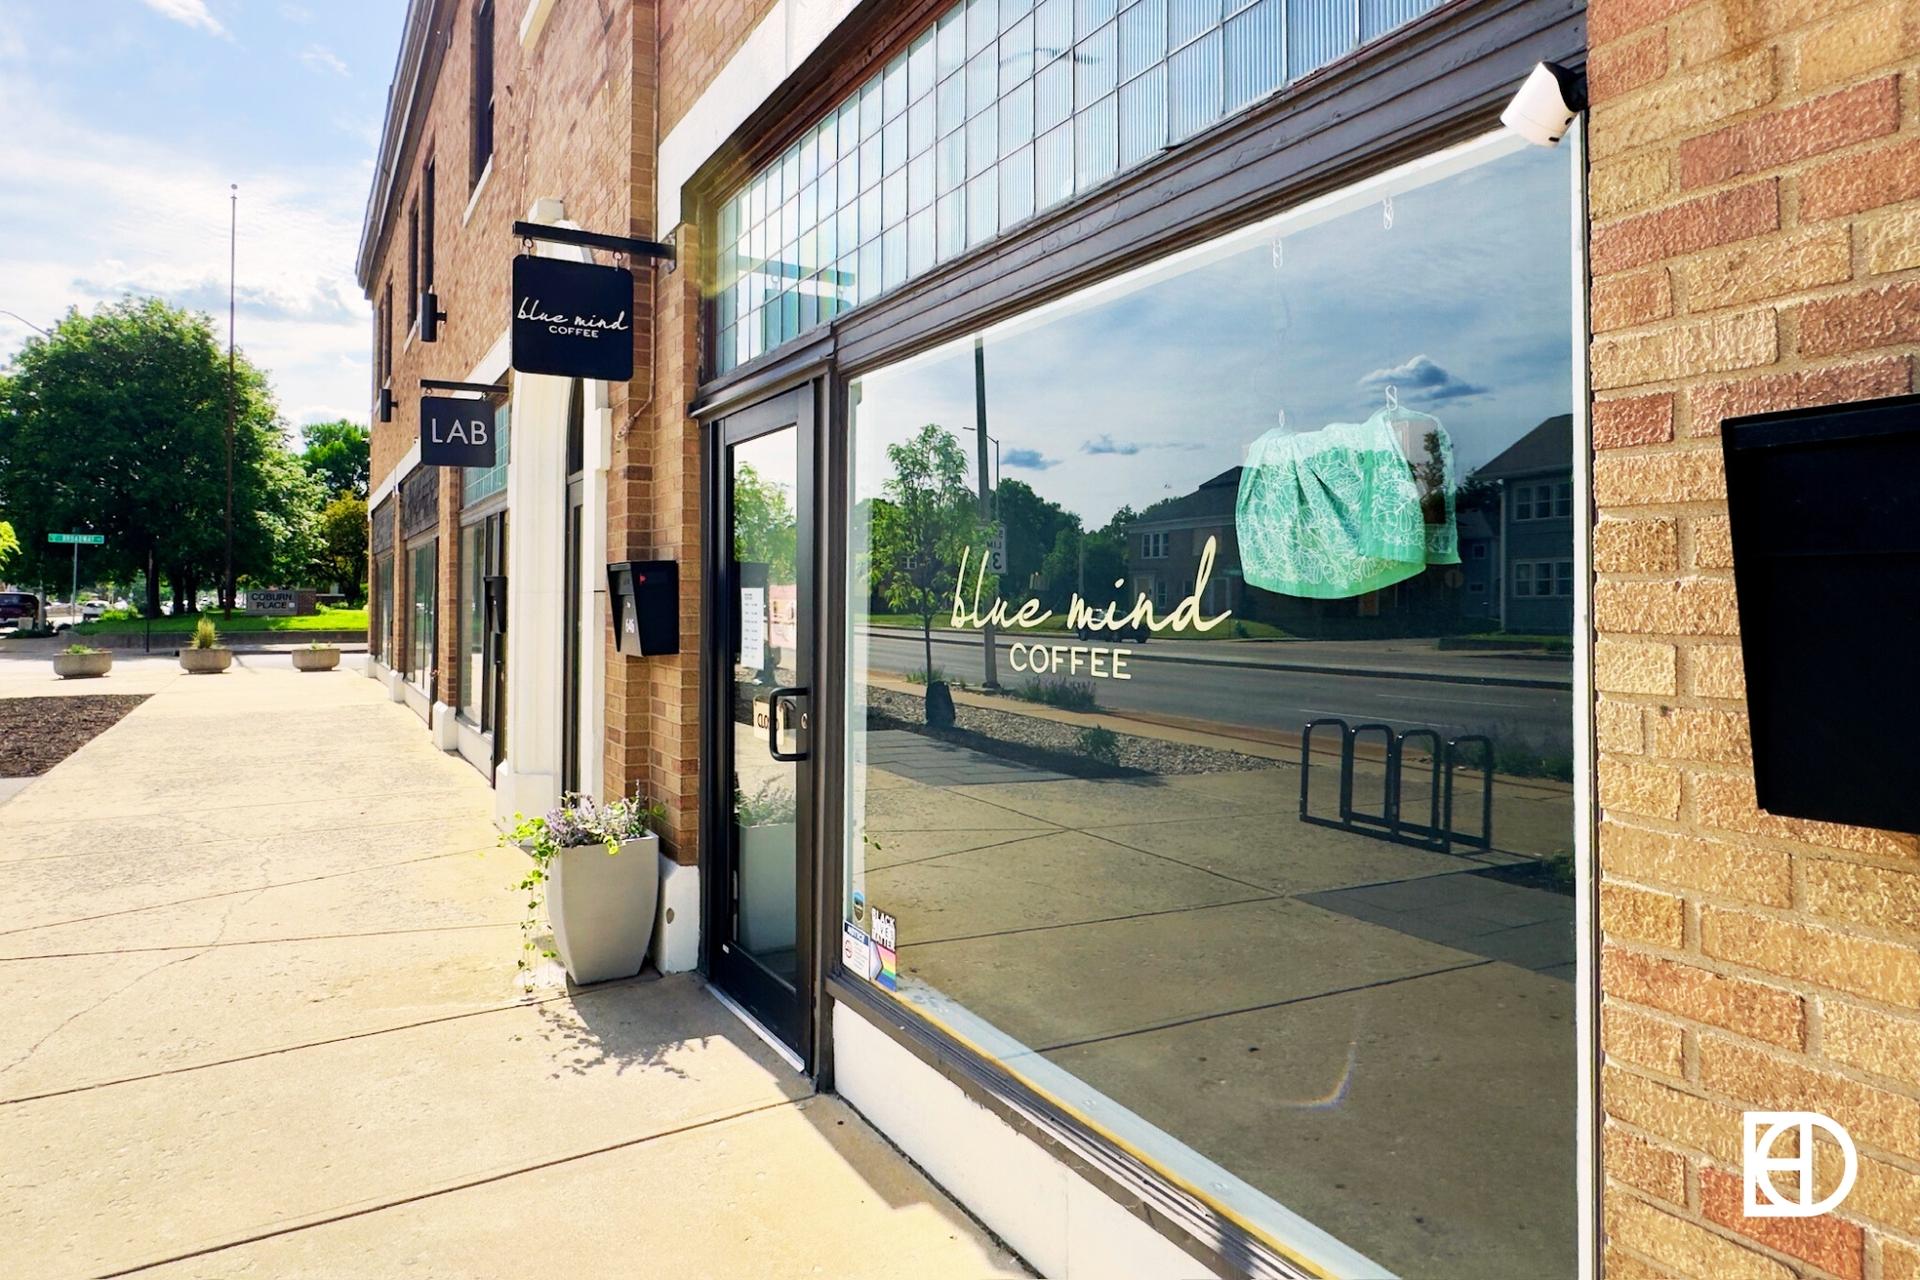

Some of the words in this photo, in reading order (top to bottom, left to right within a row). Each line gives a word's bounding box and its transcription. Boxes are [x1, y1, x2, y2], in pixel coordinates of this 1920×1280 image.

[517, 297, 568, 323] blue
[574, 311, 629, 331] mind
[549, 325, 600, 338] COFFEE
[431, 418, 488, 445] LAB
[951, 545, 1053, 629] blue
[1066, 535, 1233, 632] mind
[251, 592, 293, 601] COBURN
[256, 601, 287, 609] PLACE
[1009, 642, 1132, 680] COFFEE
[757, 713, 780, 731] CLOD
[871, 907, 896, 927] BLACK
[871, 927, 896, 951] MATTER
